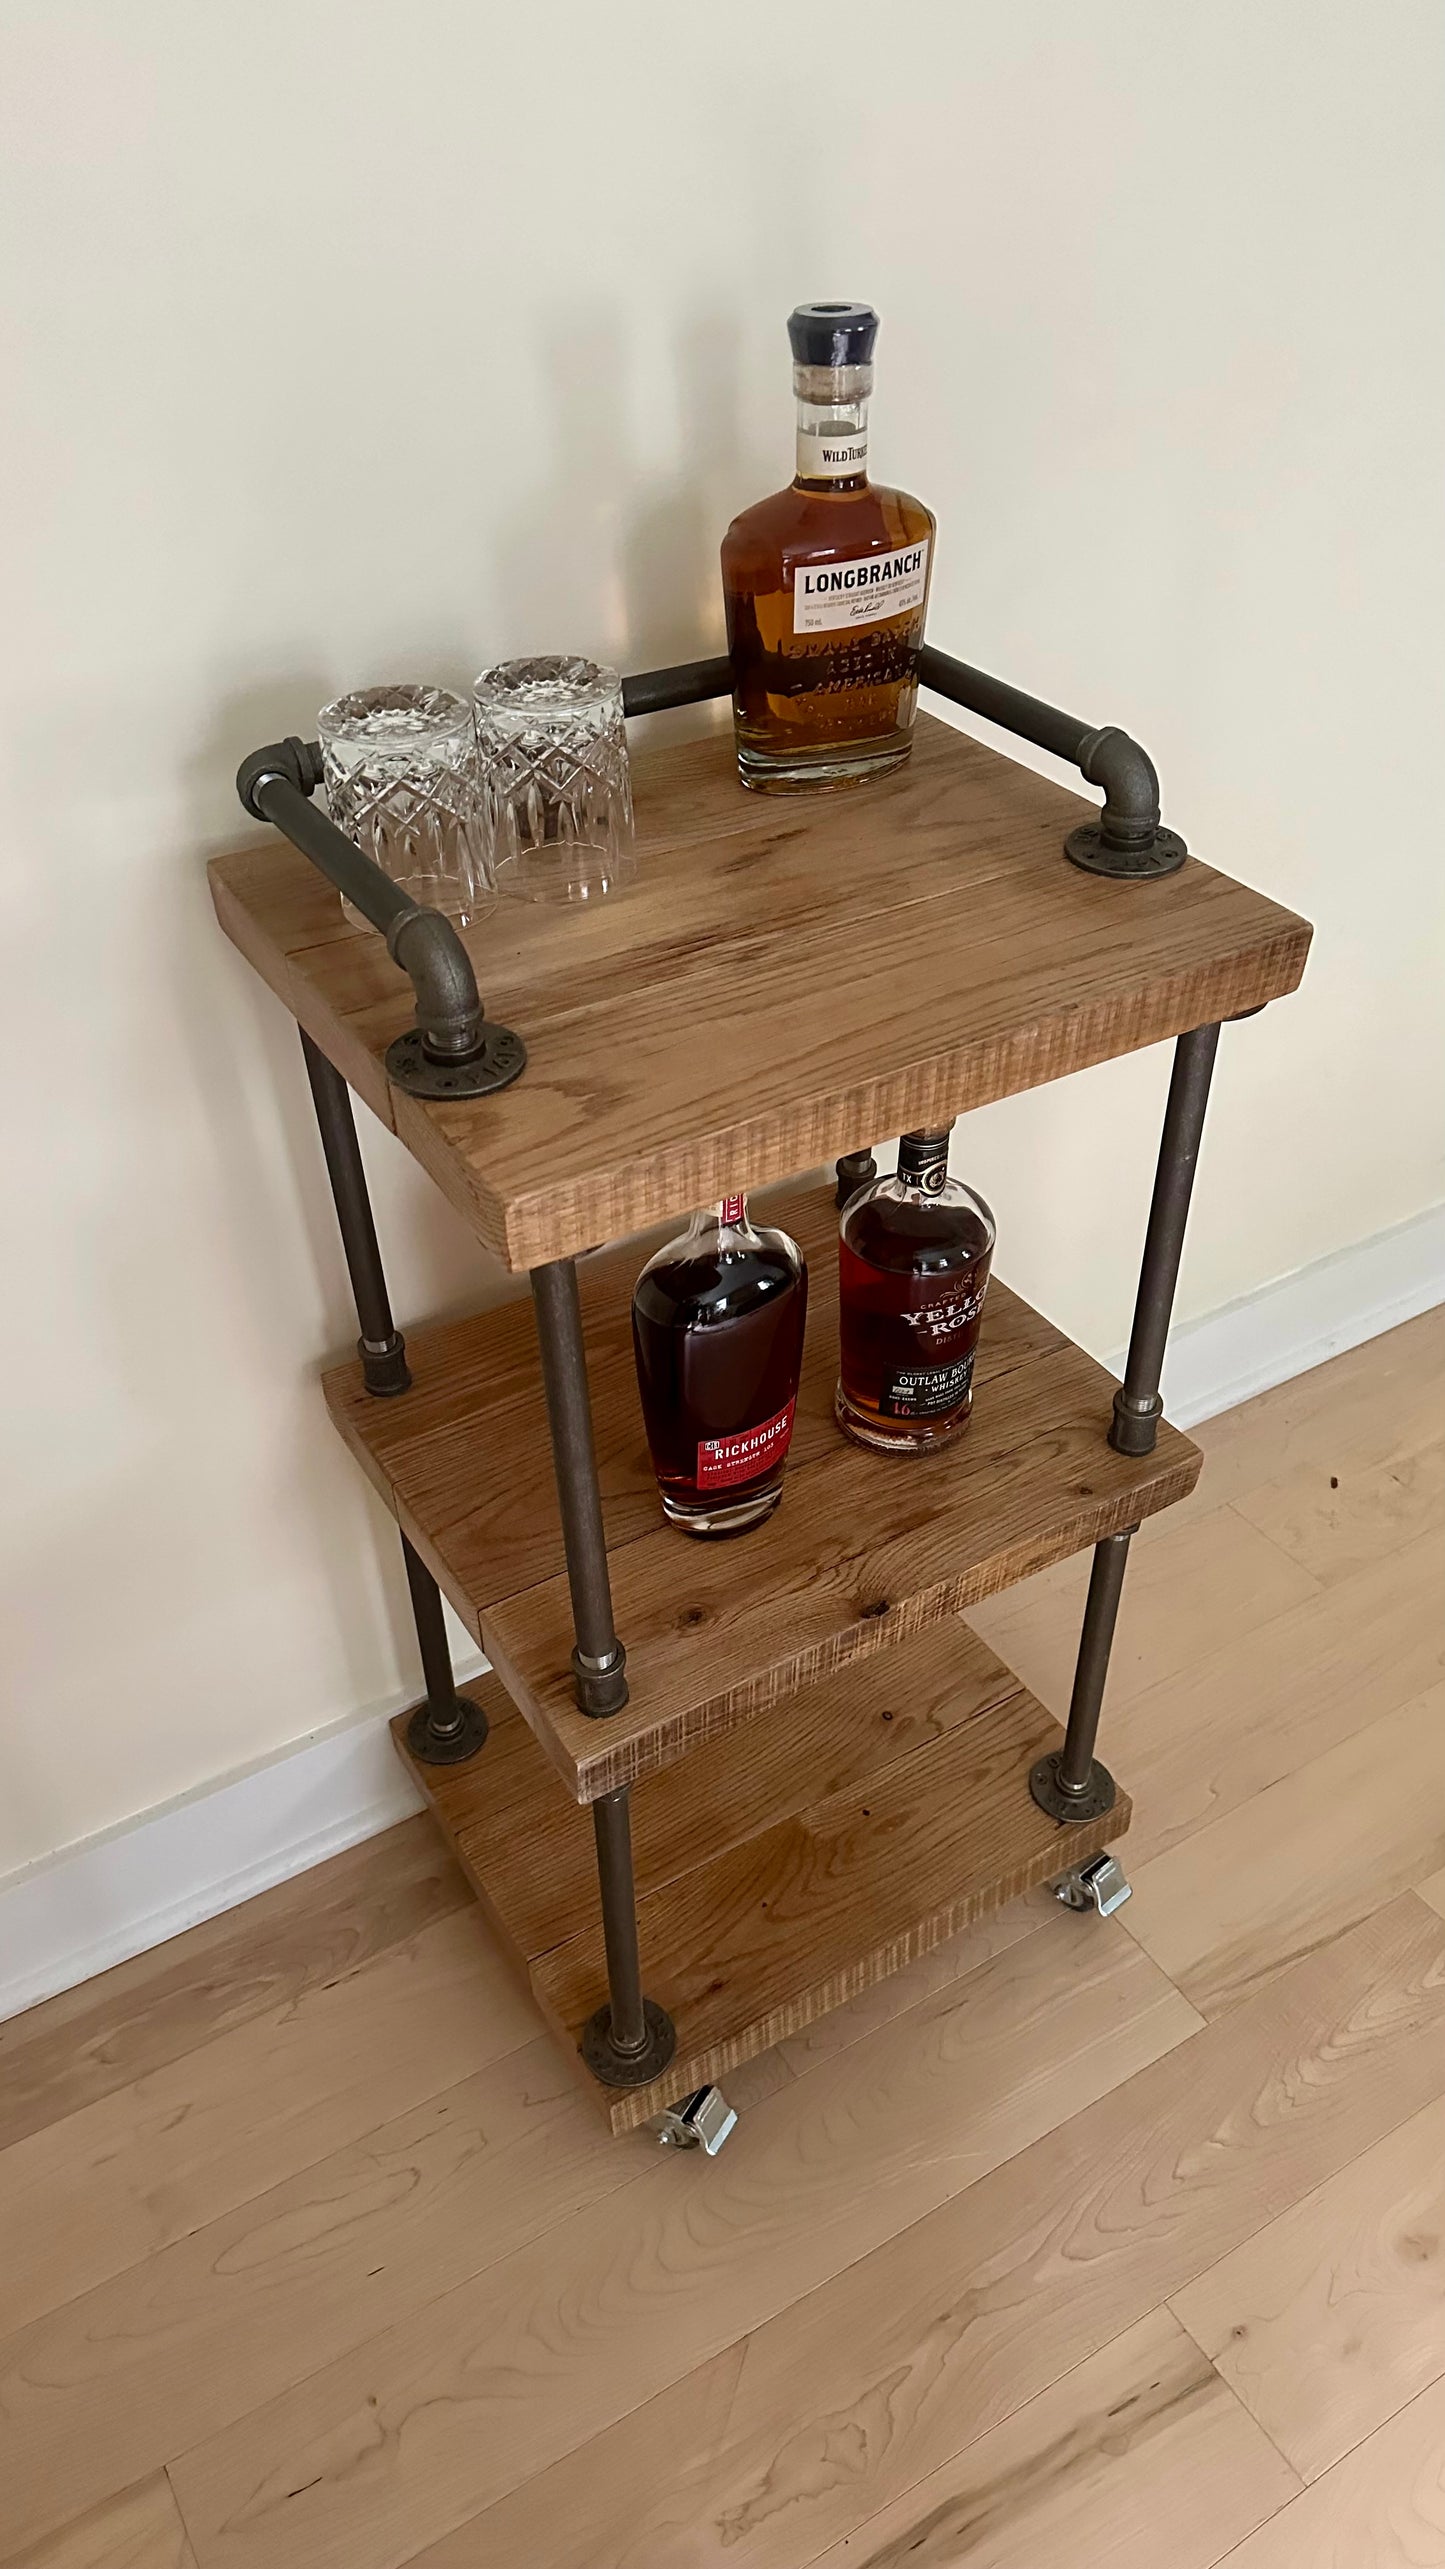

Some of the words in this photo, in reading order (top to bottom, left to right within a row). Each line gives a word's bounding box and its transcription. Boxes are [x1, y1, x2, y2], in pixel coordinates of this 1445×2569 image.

[822, 450, 848, 462] WILD
[804, 550, 922, 595] LONGBRANCH
[902, 1172, 912, 1184] TX
[899, 1372, 948, 1386] OUTLAW
[931, 1371, 968, 1393] WHISKEY
[715, 1415, 788, 1460] RICKHOUSE
